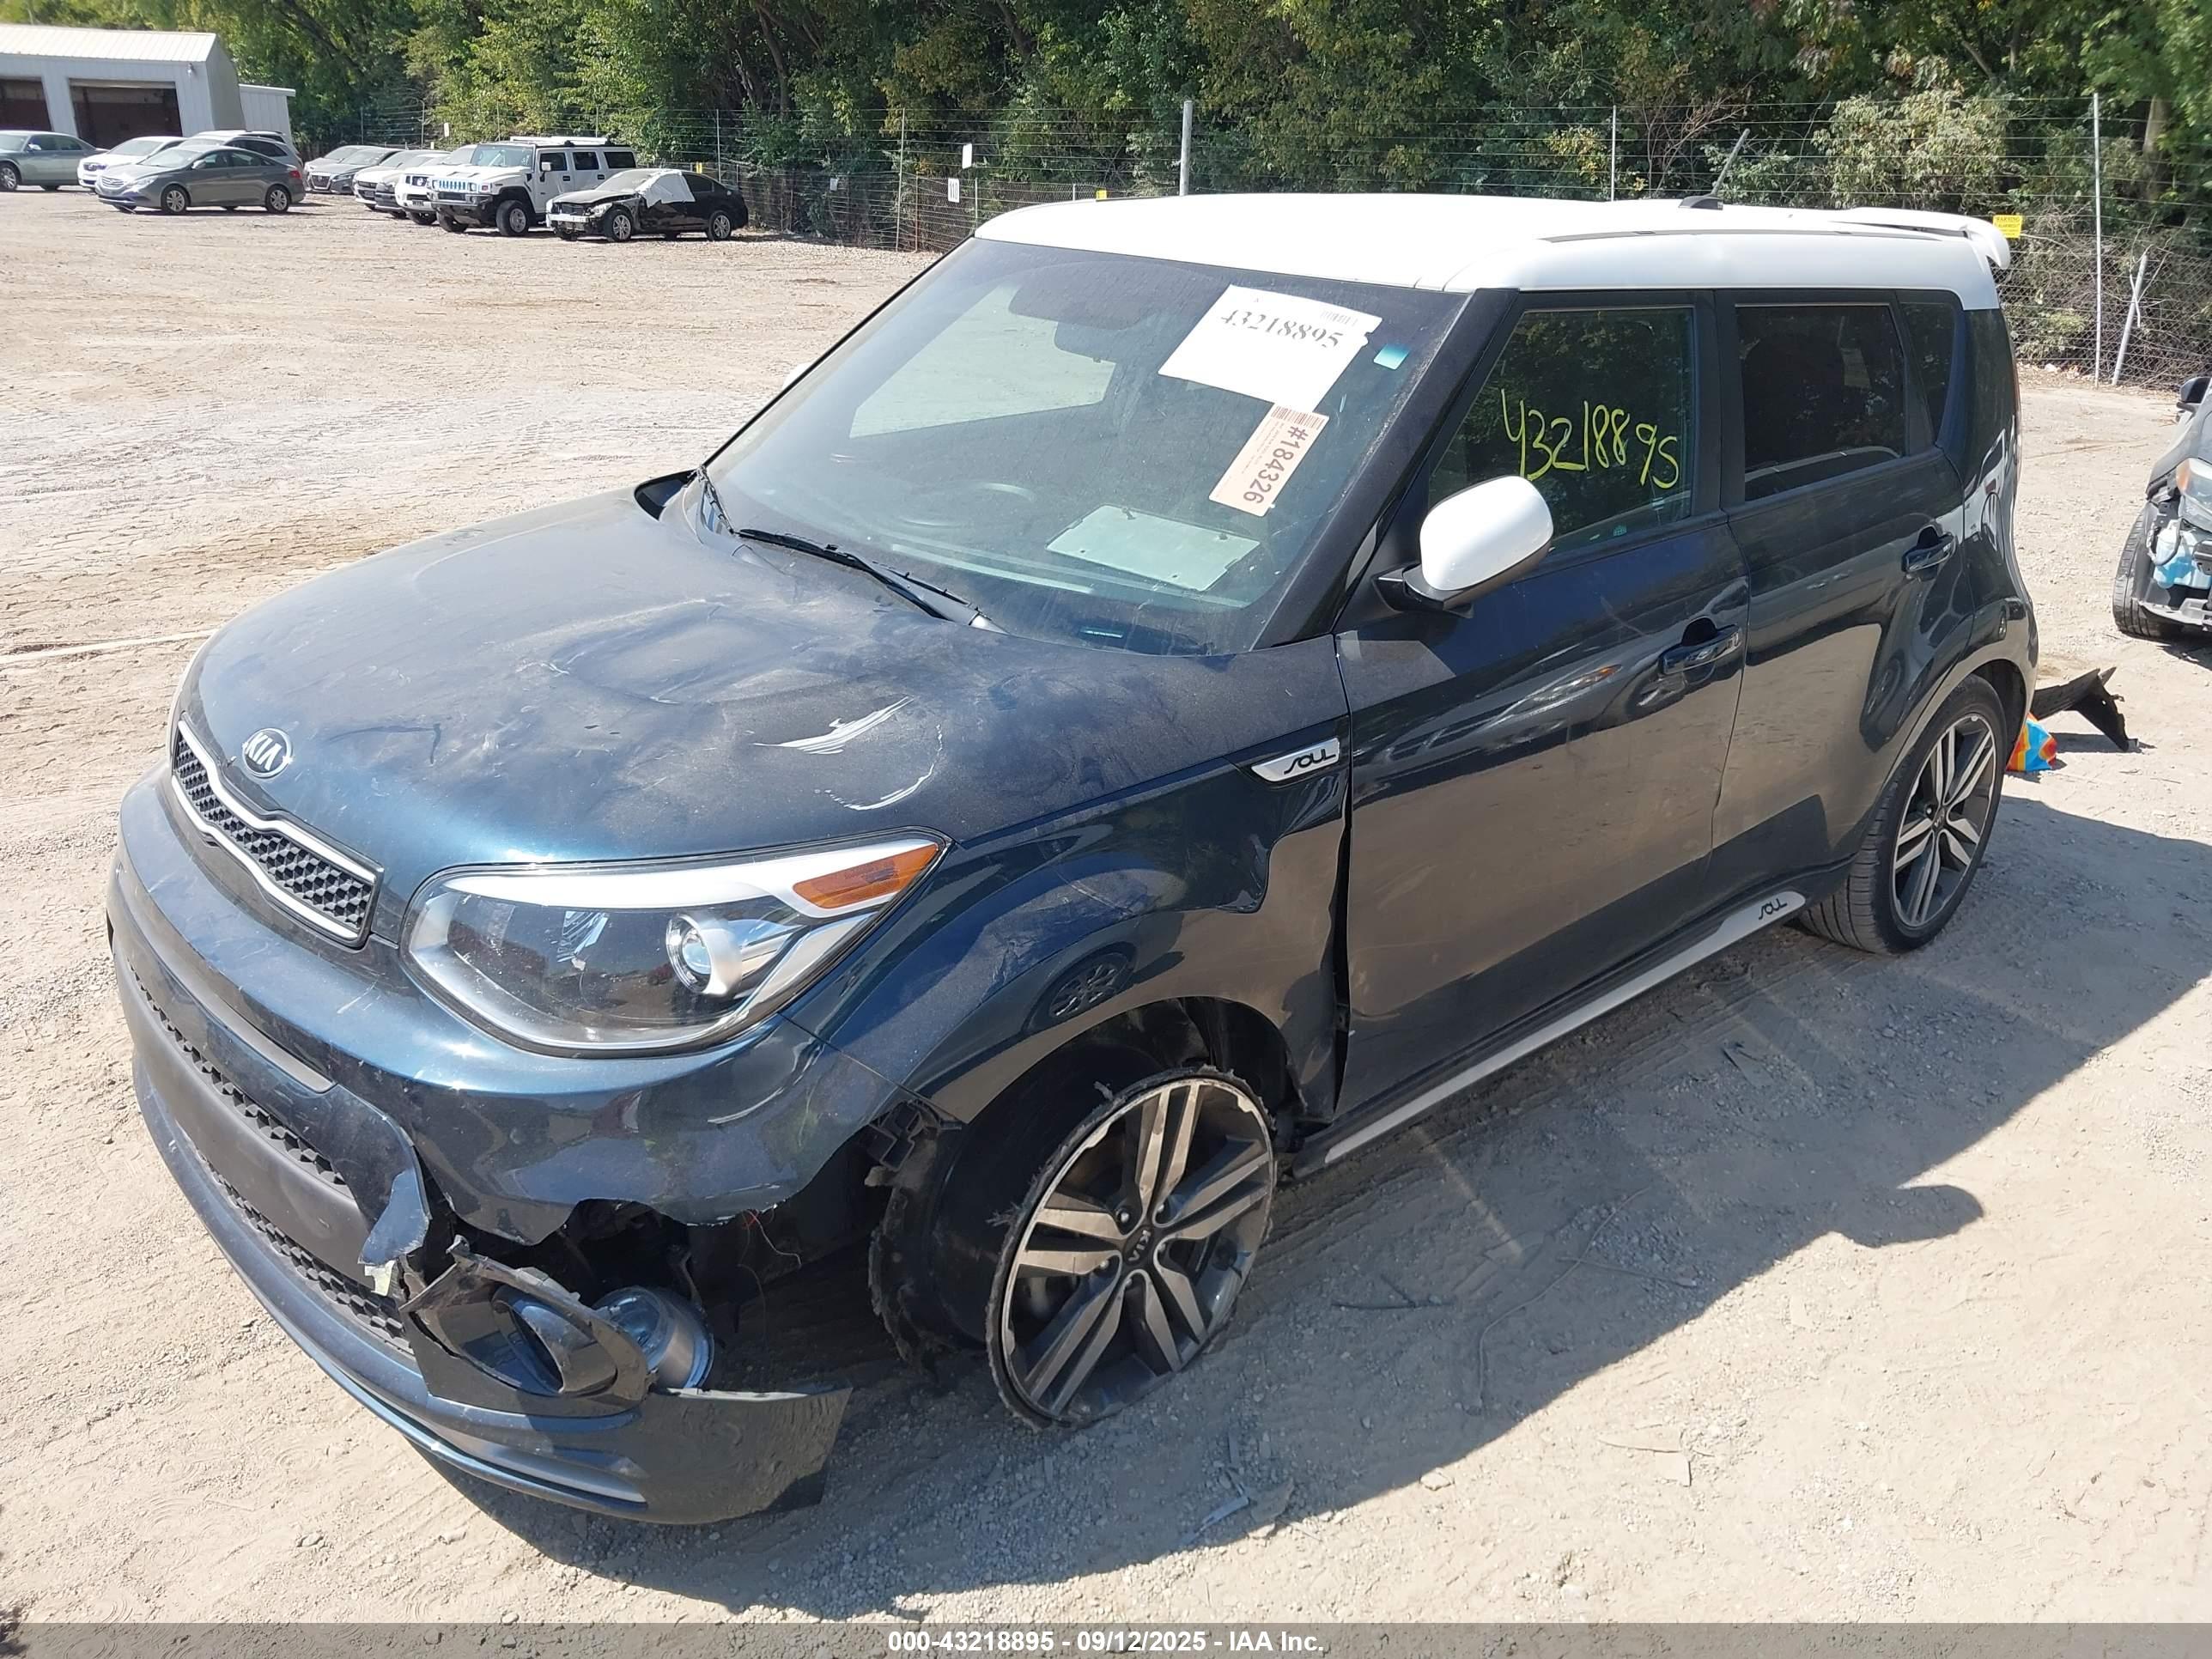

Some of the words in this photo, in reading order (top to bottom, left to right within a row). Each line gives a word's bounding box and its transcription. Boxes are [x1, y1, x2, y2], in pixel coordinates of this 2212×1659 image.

[1220, 309, 1344, 348] 43218895
[1500, 387, 1680, 489] 43218895
[1243, 426, 1309, 504] #184326
[245, 731, 283, 771] KIA
[1283, 748, 1336, 775] SOUL
[1758, 898, 1788, 921] SOUL
[1127, 1230, 1152, 1261] KIA
